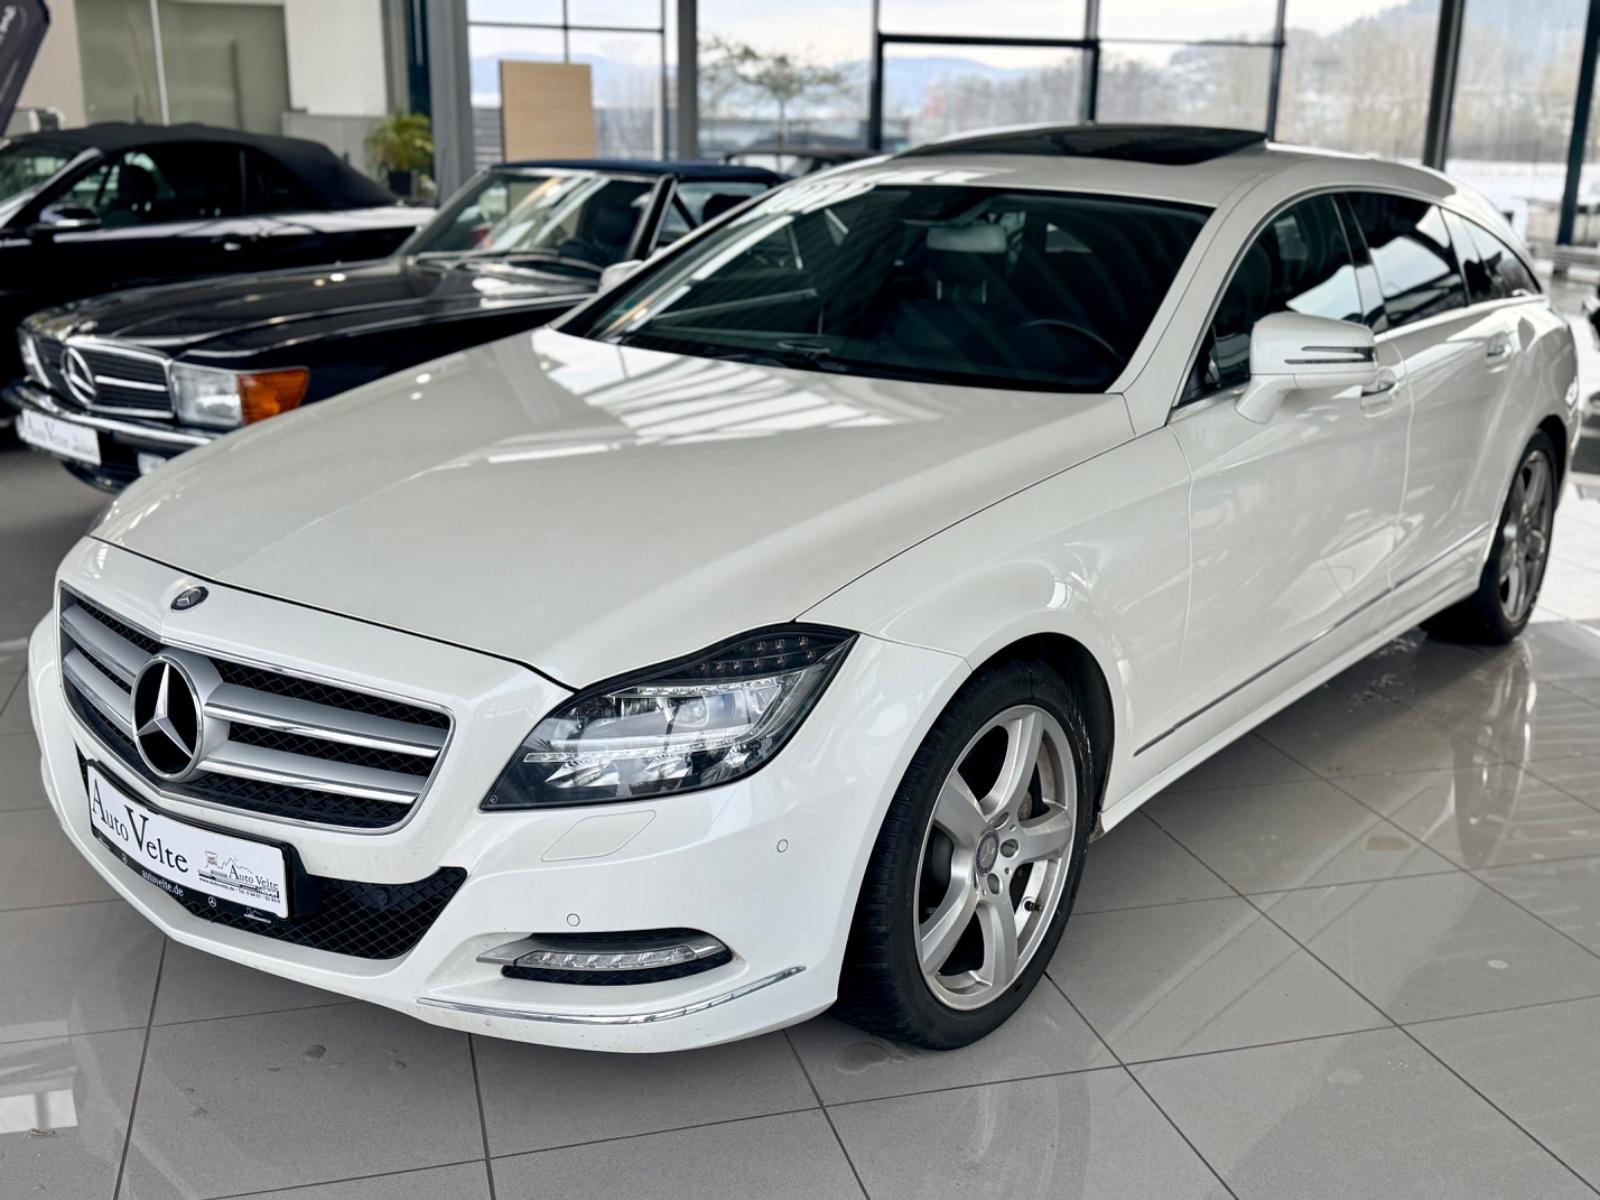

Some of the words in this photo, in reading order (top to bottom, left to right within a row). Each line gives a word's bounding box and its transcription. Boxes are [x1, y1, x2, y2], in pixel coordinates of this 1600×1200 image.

[92, 779, 129, 842] Auto
[124, 804, 189, 873] Velte
[141, 870, 185, 897] autovelte.de
[229, 864, 254, 884] Auto
[255, 875, 279, 890] Velte
